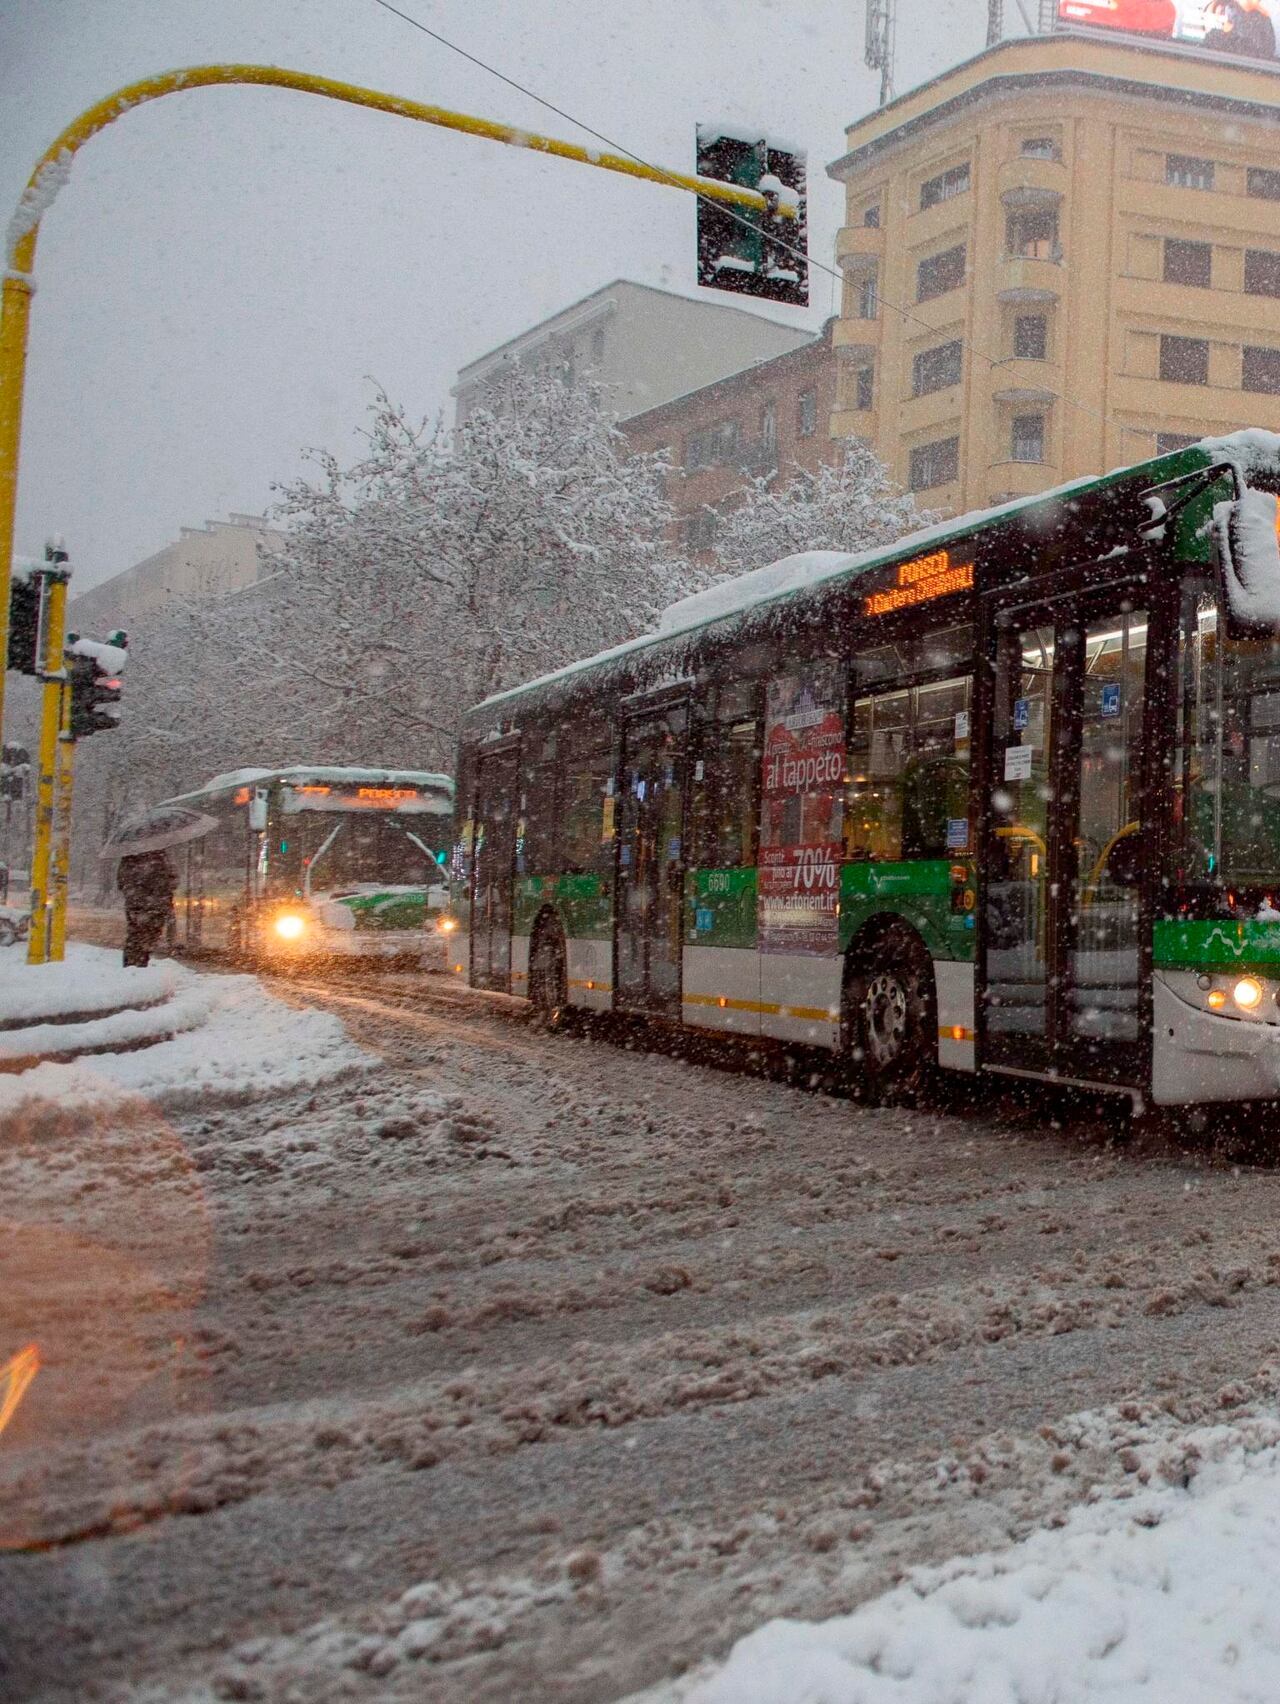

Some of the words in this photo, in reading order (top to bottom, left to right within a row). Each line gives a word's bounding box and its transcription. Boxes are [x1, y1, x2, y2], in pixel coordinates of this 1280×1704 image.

[766, 757, 779, 789] al
[783, 751, 841, 793] tappeto
[709, 873, 730, 892] 6690
[793, 847, 835, 889] 70%
[763, 891, 834, 911] www.artorient.it
